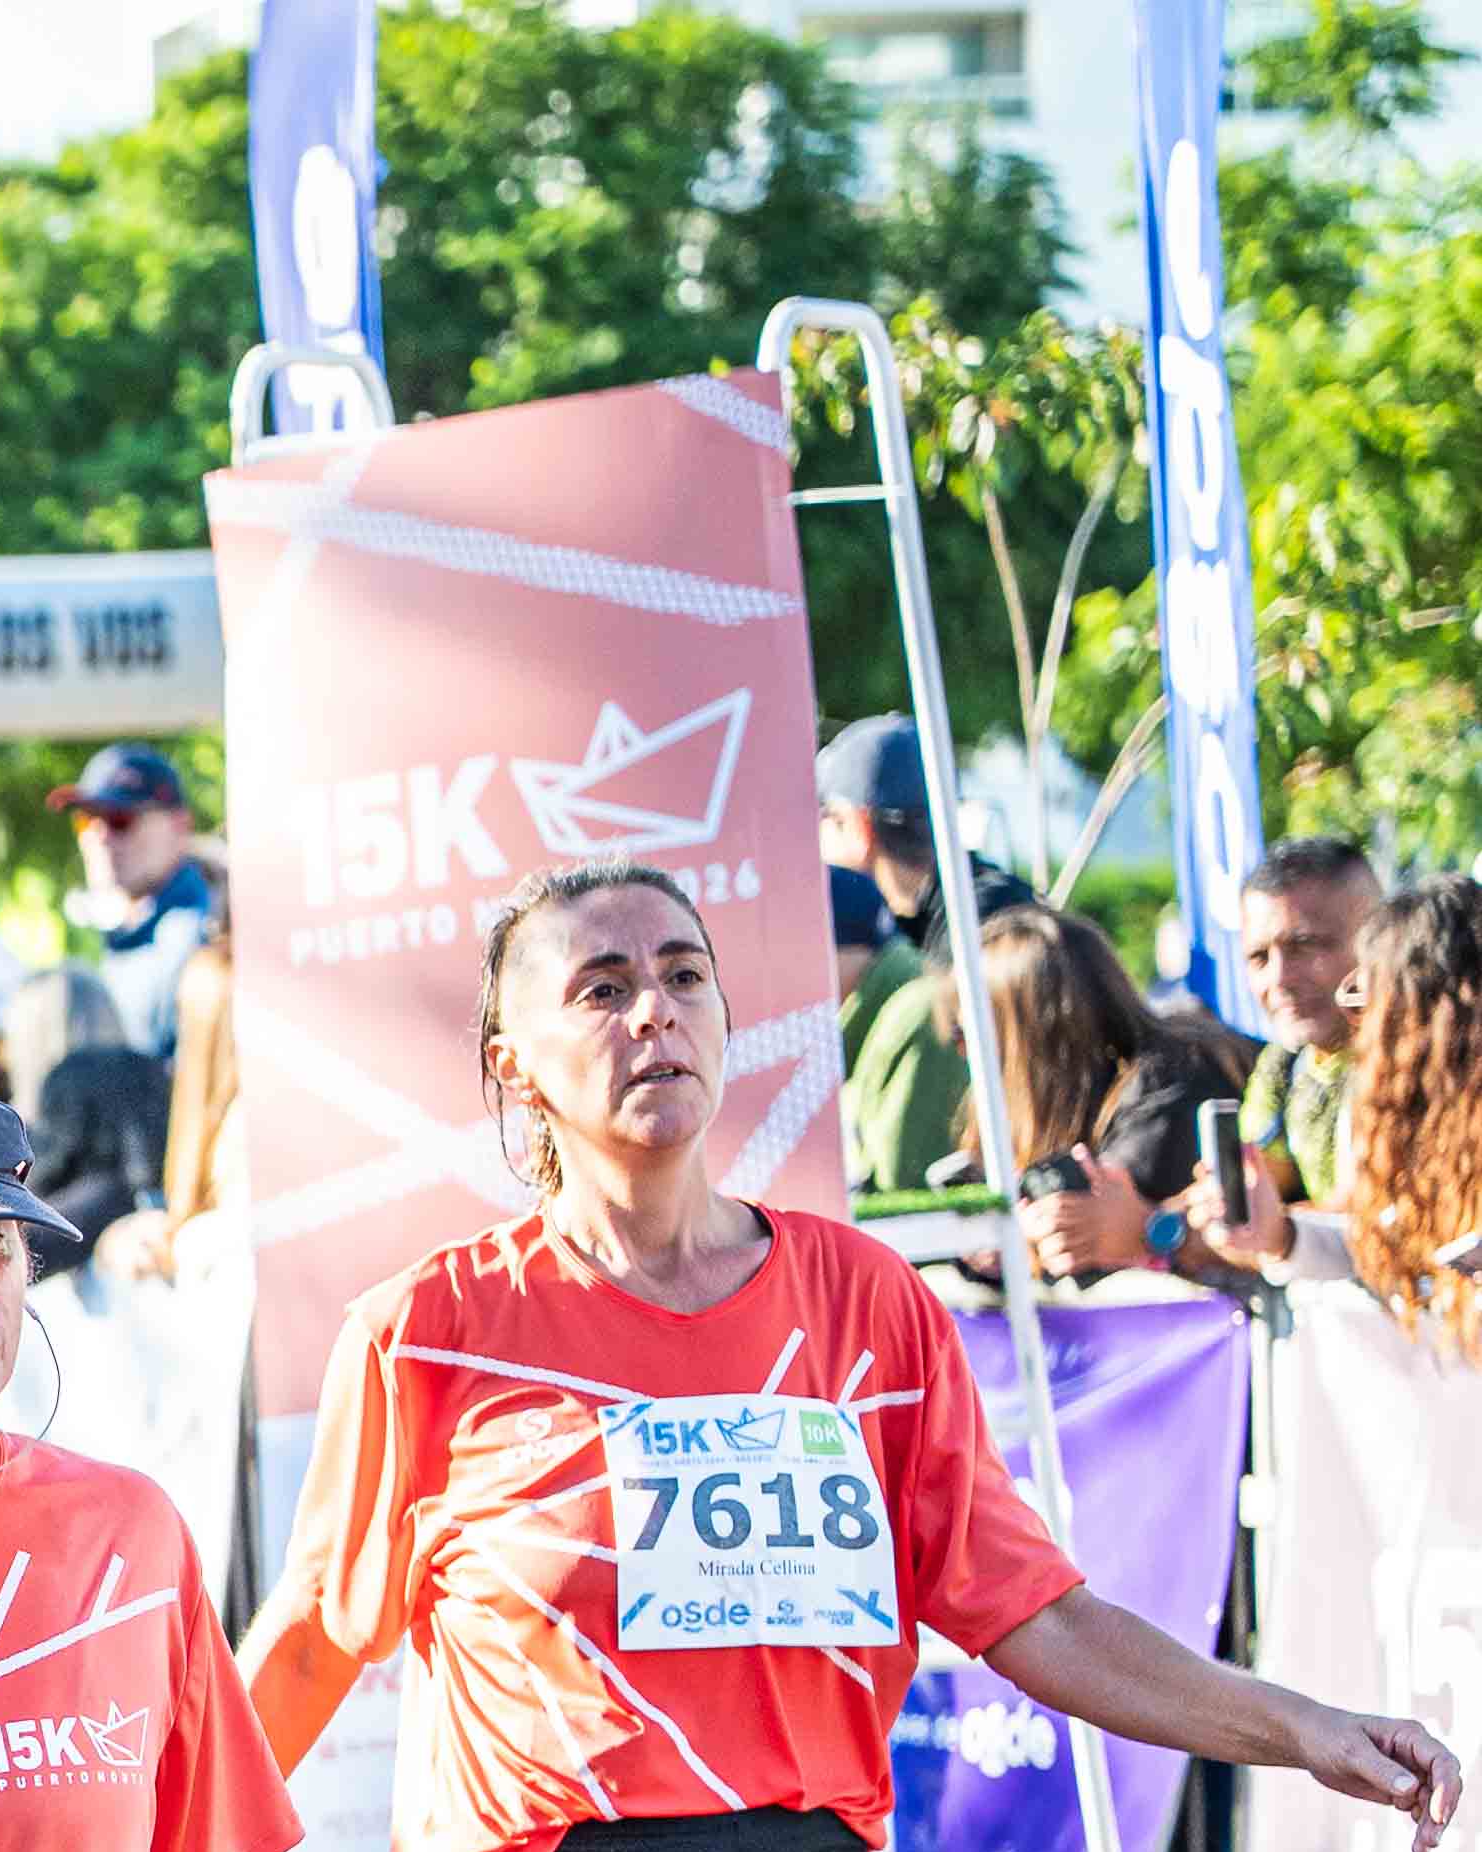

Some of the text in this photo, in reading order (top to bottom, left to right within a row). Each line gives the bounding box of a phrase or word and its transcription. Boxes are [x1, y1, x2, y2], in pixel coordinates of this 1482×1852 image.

[284, 752, 508, 905] 15K
[290, 904, 456, 967] PUERTO
[635, 1418, 840, 1456] 15K 10K
[623, 1472, 880, 1552] 7618
[661, 1595, 751, 1632] osde
